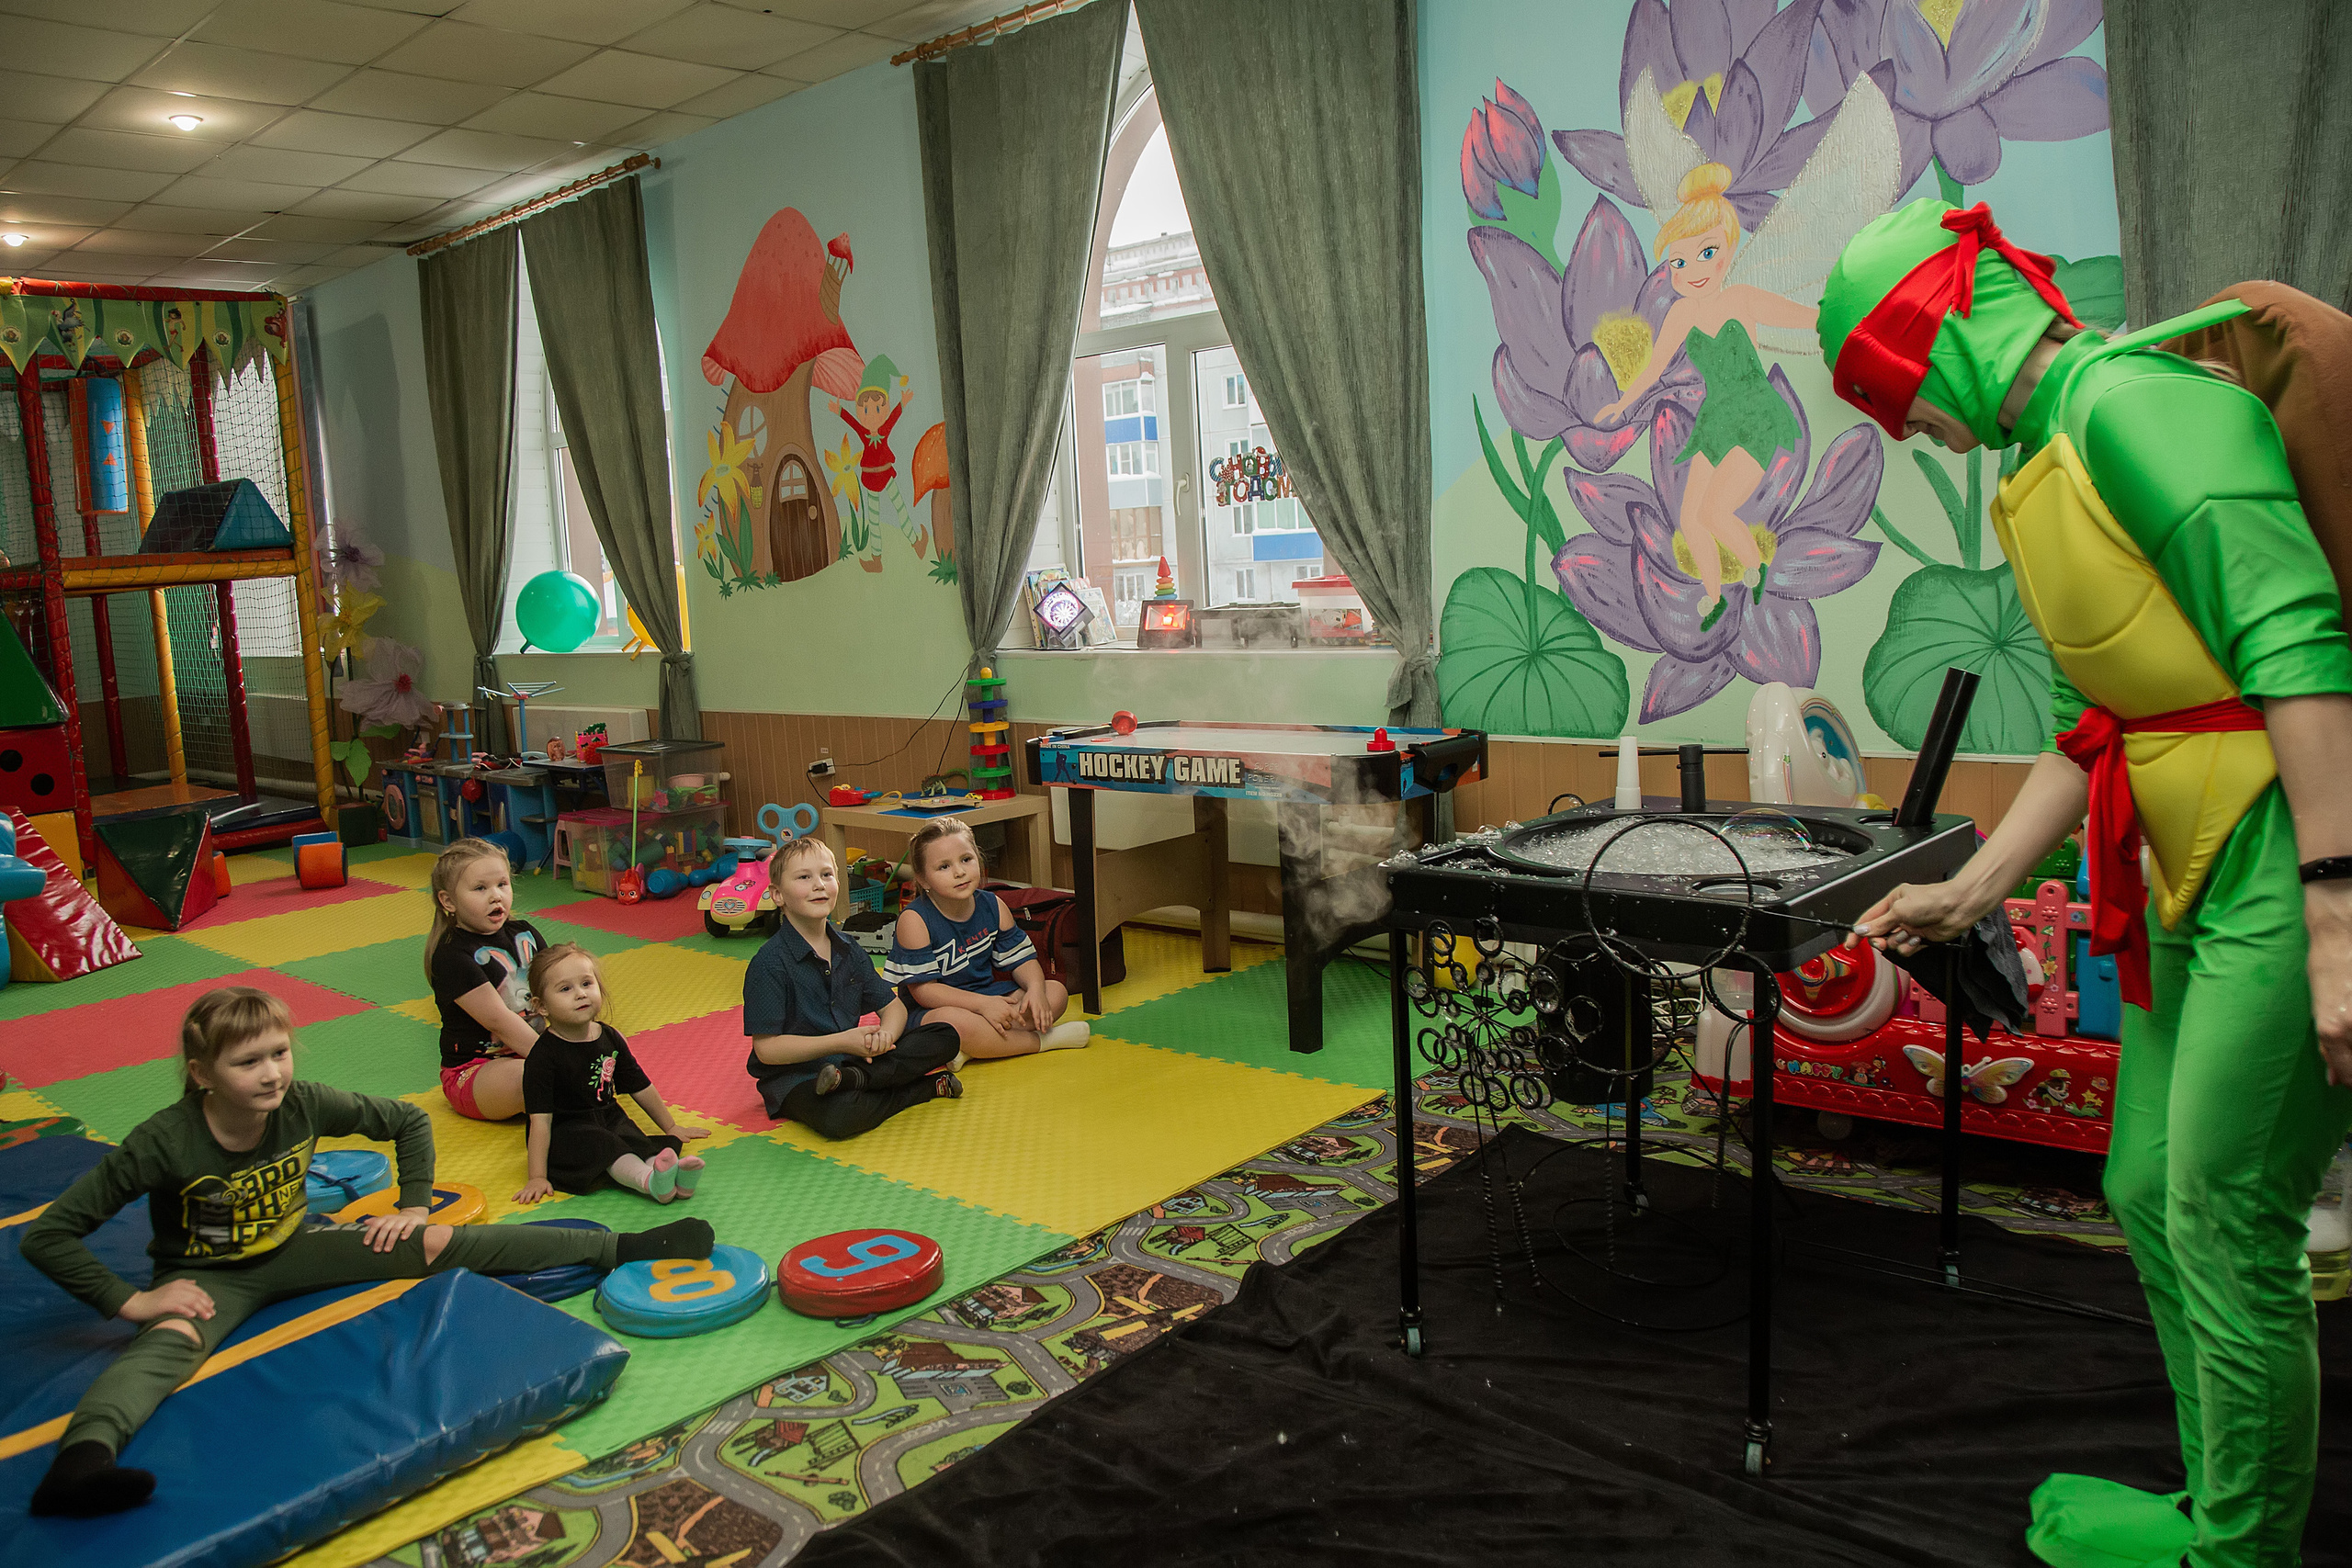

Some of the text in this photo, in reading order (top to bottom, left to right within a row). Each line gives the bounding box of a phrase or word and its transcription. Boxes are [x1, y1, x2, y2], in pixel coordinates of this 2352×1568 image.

[1078, 751, 1241, 785] HOCKEY GAME
[1254, 761, 1279, 771] SUPER
[1248, 773, 1275, 783] POWER
[1787, 1059, 1844, 1080] HAPPY
[649, 1258, 737, 1303] 8
